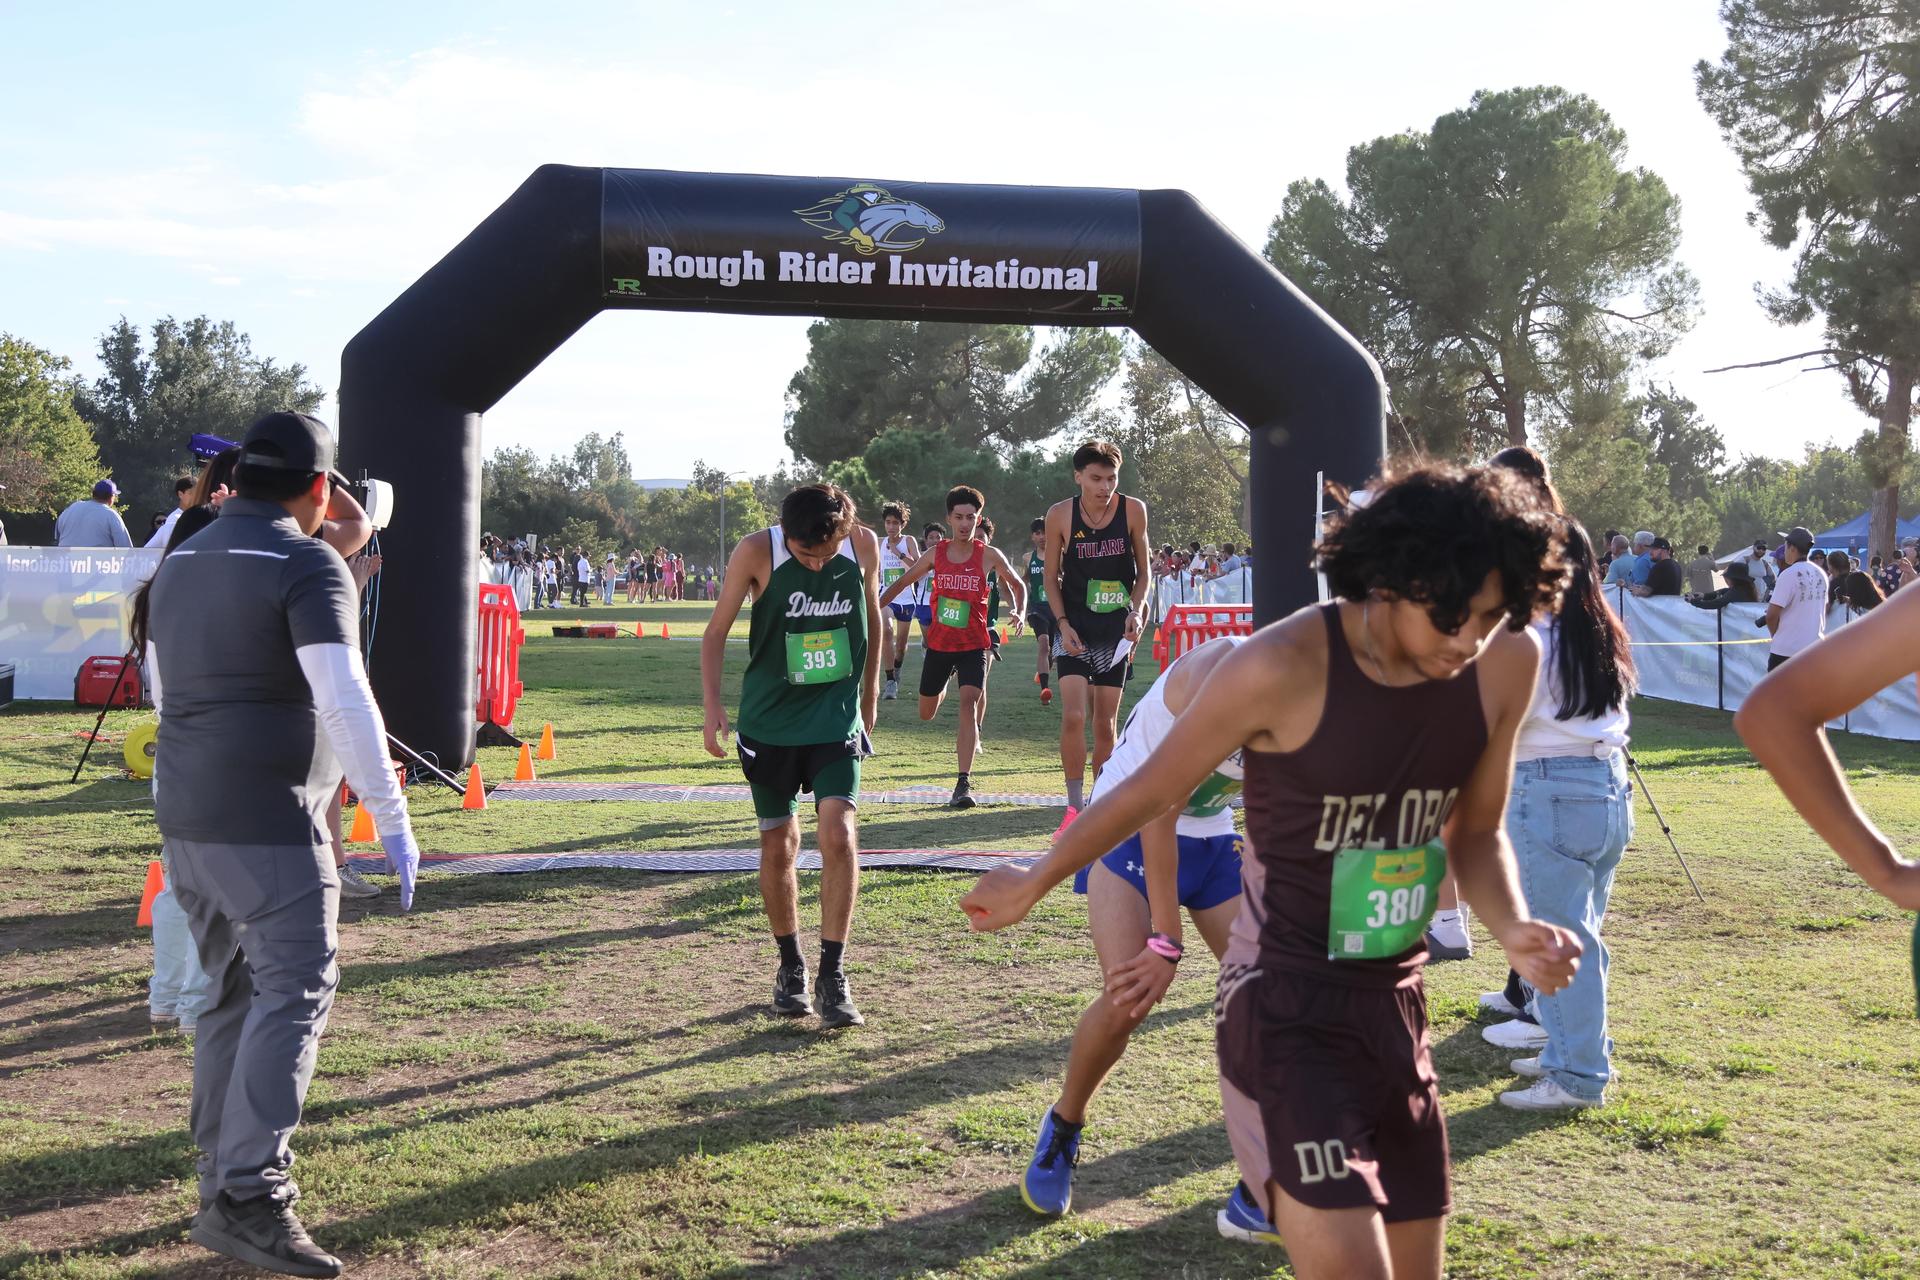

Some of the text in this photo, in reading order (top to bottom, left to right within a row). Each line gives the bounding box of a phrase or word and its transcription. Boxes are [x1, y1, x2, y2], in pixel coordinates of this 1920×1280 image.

[647, 246, 1098, 291] Rough Rider Invitational
[1076, 538, 1126, 559] TULARE
[937, 573, 981, 592] TRIBE
[785, 590, 853, 618] Dinuba
[1094, 592, 1124, 605] 1928
[942, 607, 960, 621] 281
[802, 649, 837, 670] 393
[1313, 793, 1387, 852] DEL
[1366, 882, 1427, 929] 380
[1293, 1138, 1350, 1184] DO
